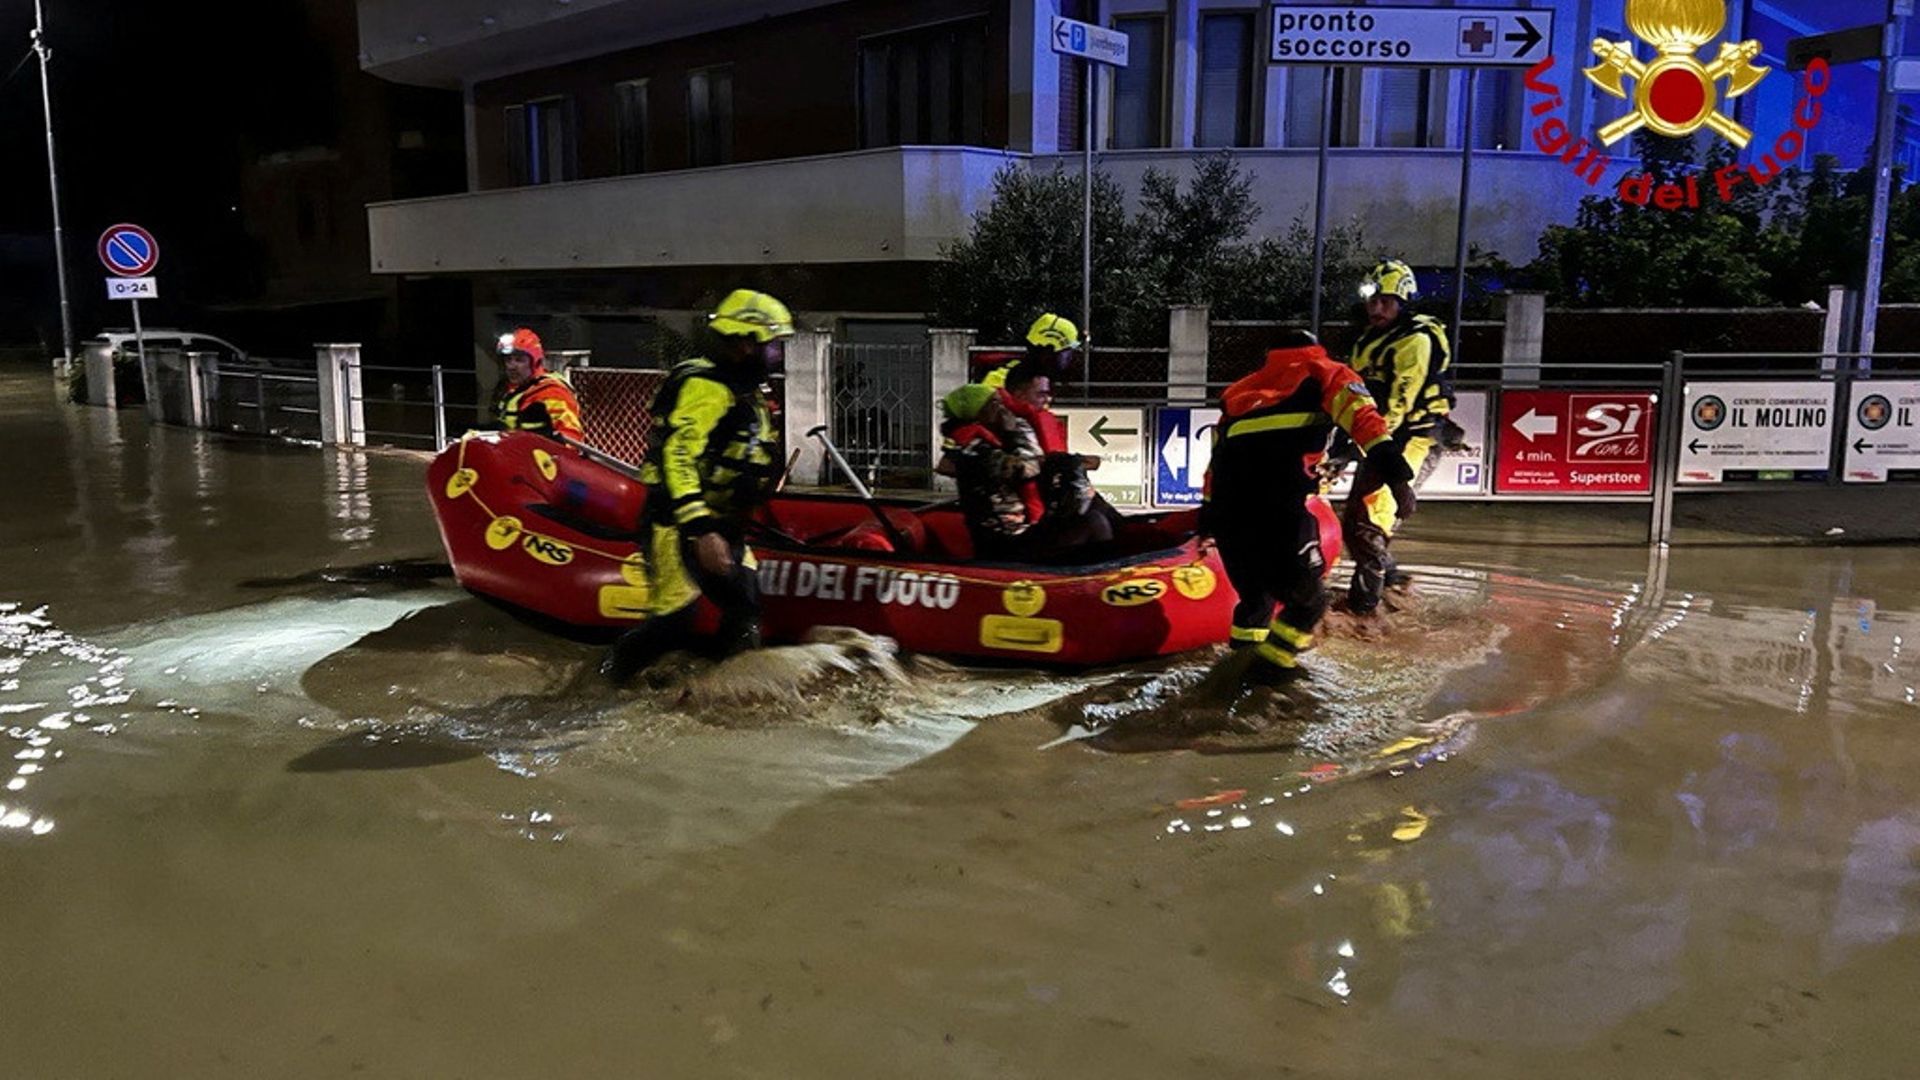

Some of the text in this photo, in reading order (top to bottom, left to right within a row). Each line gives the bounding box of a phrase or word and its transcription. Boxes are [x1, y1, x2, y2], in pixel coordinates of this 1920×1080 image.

[1278, 10, 1375, 34] pronto
[1278, 38, 1411, 58] soccorso
[115, 283, 149, 294] 0-24
[1731, 407, 1827, 428] IL MOLINO
[1896, 407, 1913, 426] IL
[1114, 453, 1139, 463] food
[1515, 450, 1556, 462] 4 min.
[1594, 443, 1622, 456] con
[1569, 470, 1642, 486] Superstore
[1122, 491, 1136, 501] 17
[525, 535, 571, 562] NRS
[758, 560, 960, 610] ILI DEL FUOCO
[1107, 582, 1161, 602] NRS
